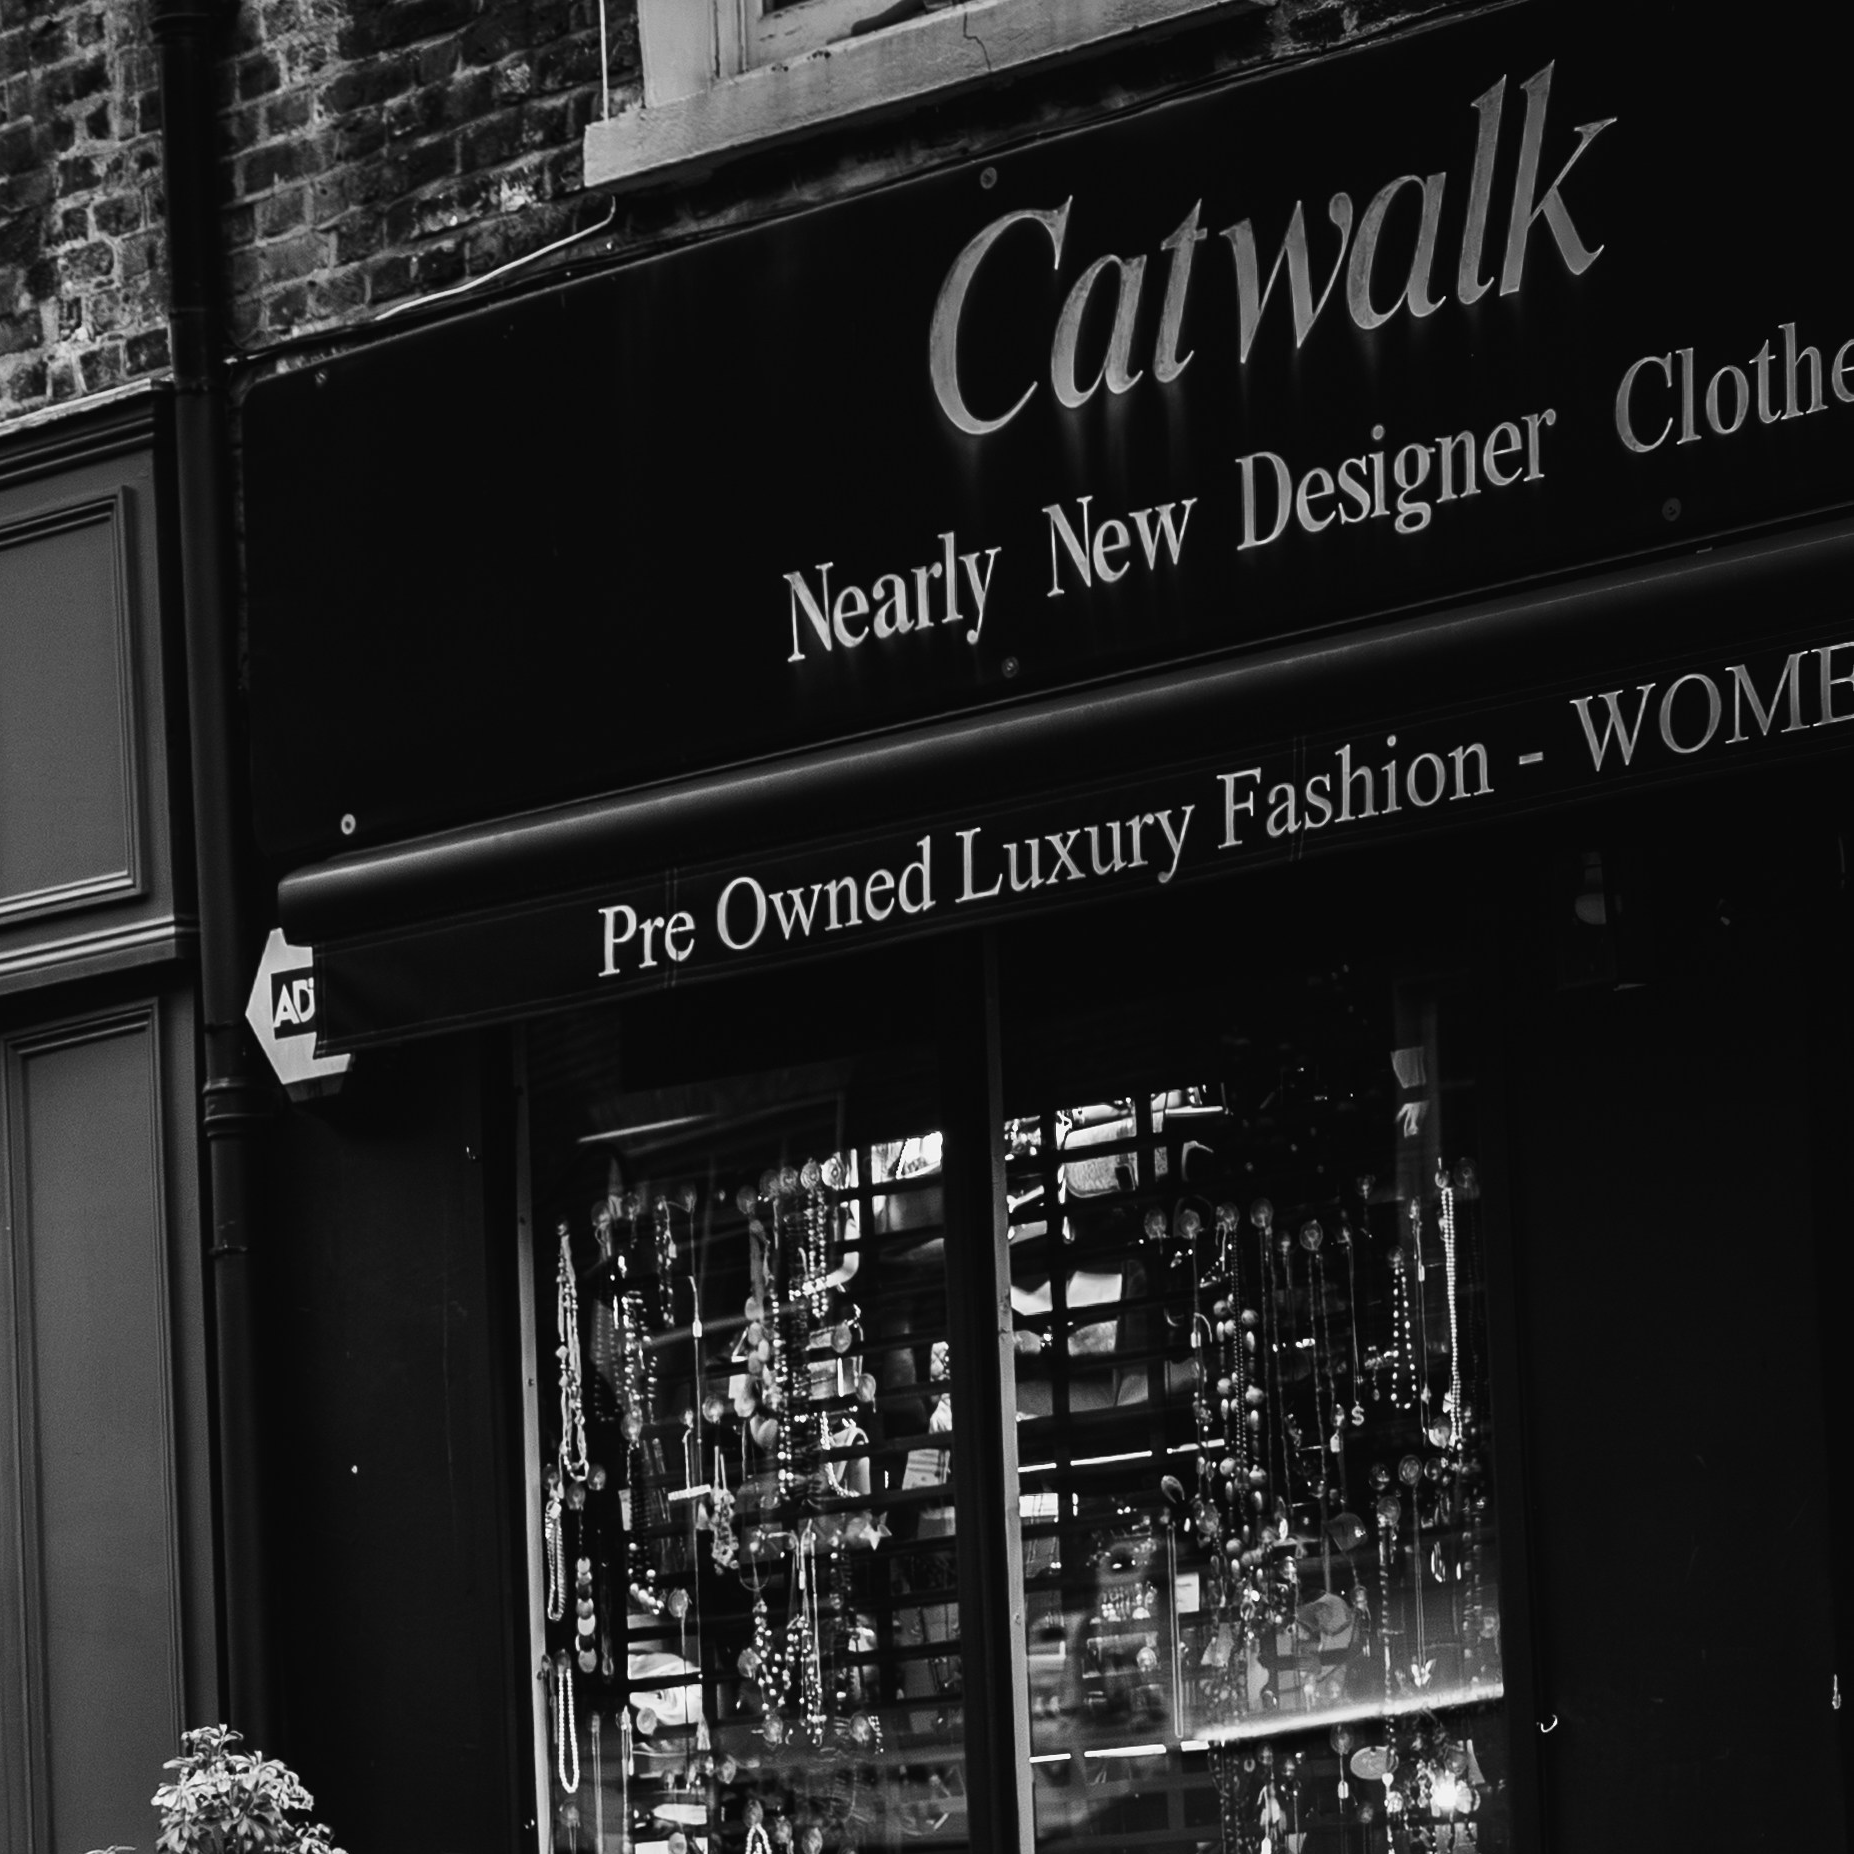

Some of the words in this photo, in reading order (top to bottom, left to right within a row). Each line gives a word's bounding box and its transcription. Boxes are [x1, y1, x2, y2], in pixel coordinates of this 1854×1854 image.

[929, 60, 1618, 436] Catwalk
[783, 531, 1003, 664] Nearly
[1042, 495, 1198, 598] New
[1235, 409, 1557, 552] Designer
[597, 904, 696, 978] Pre
[716, 836, 937, 951] Owned
[955, 801, 1196, 904] Luxury
[1216, 734, 1495, 849] Fashion
[273, 976, 316, 1028] AD
